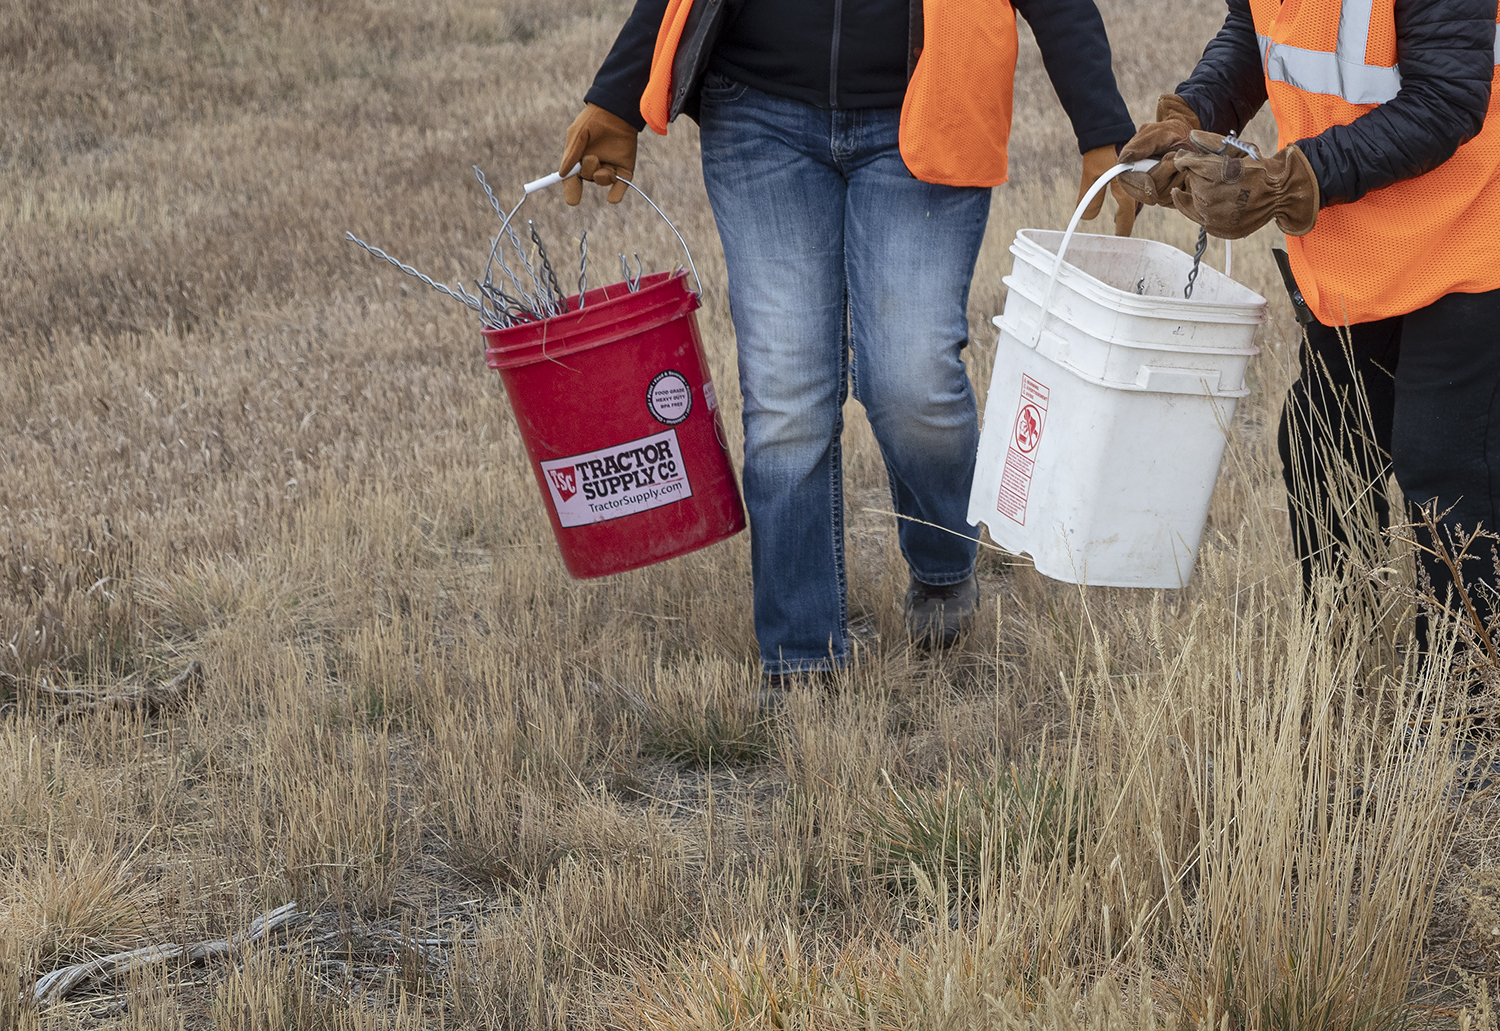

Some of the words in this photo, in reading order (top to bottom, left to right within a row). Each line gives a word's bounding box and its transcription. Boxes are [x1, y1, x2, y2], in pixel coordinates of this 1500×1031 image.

[575, 439, 673, 482] TRACTOR
[549, 469, 576, 494] TSC
[582, 466, 656, 501] SUPPLY
[588, 482, 683, 514] TractorSupply.com
